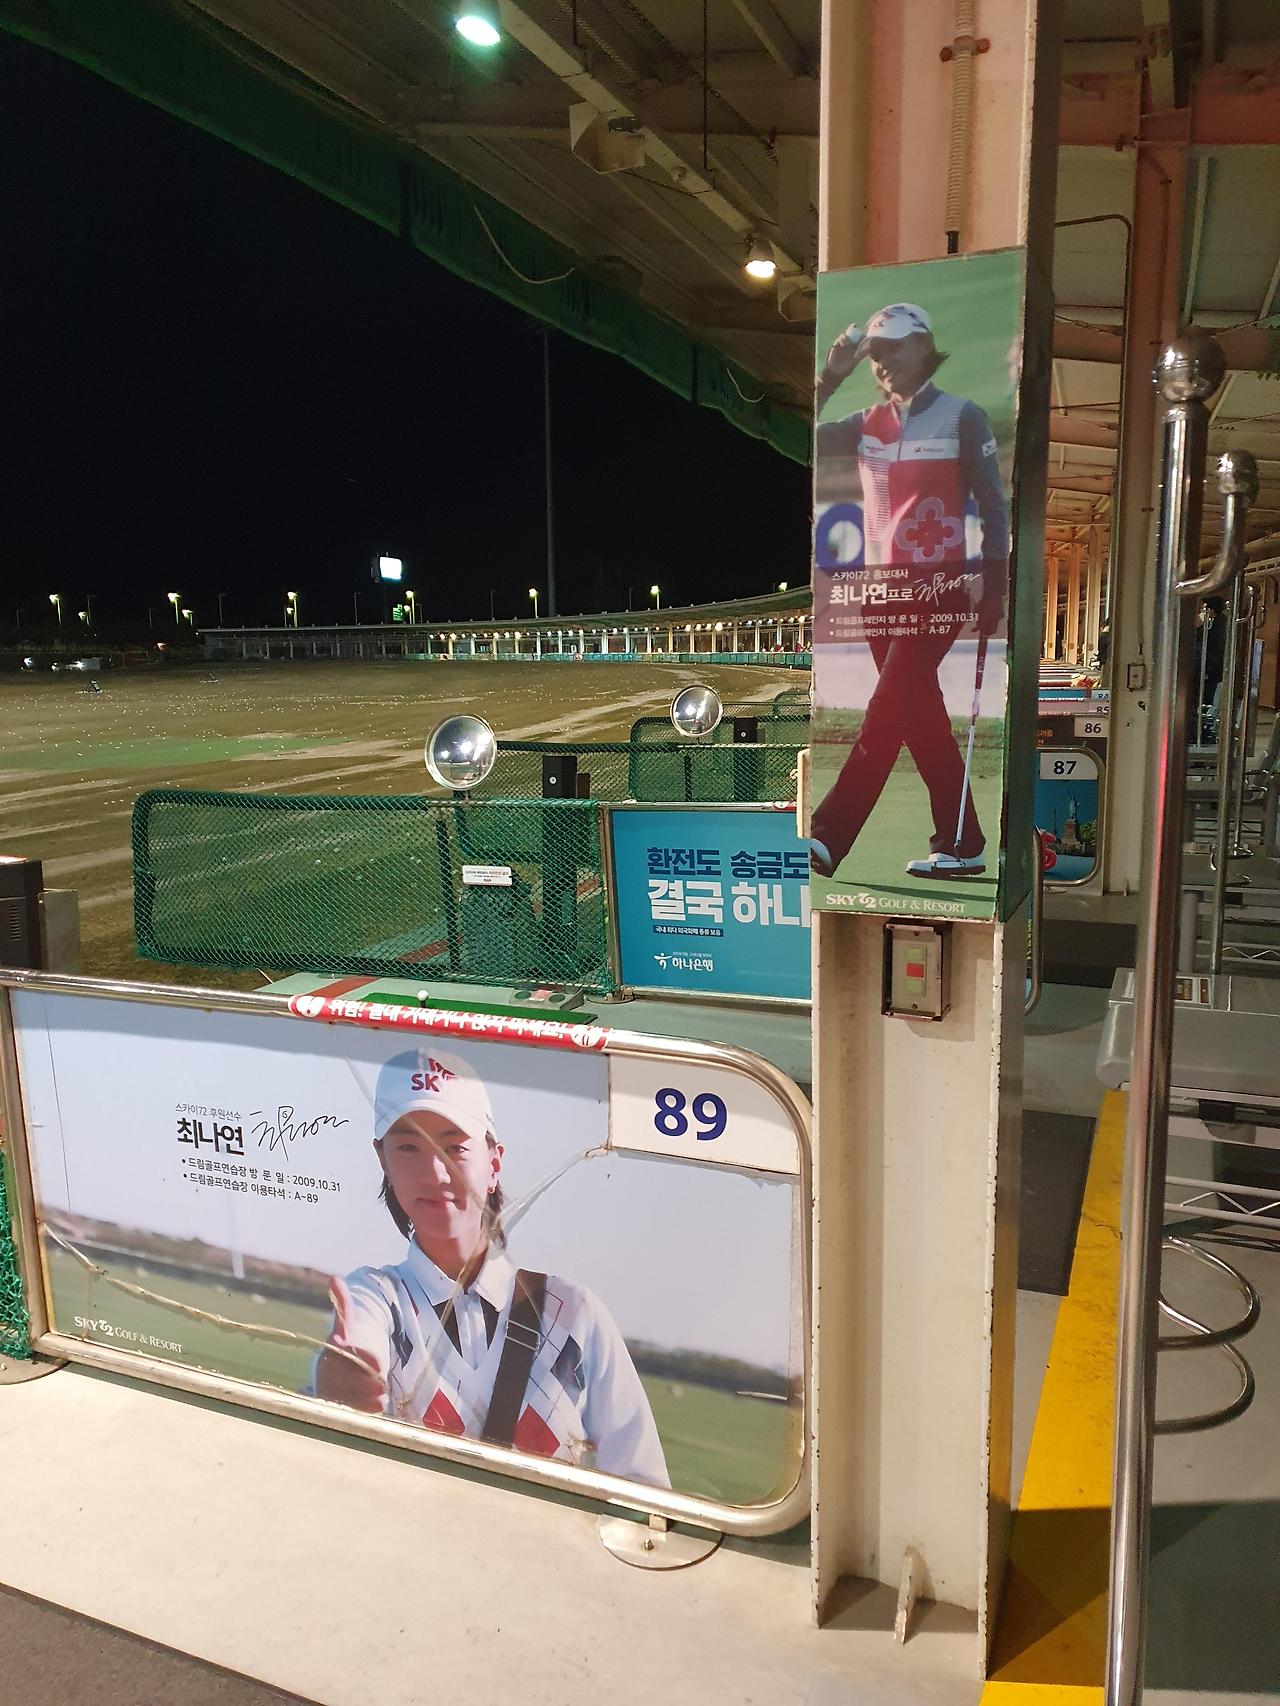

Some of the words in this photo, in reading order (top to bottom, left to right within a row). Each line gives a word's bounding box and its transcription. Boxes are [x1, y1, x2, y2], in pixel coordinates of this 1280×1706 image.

[831, 570, 870, 581] 스카이72
[873, 568, 909, 580] 홍보대사
[929, 613, 979, 623] 2009.10.31
[929, 625, 951, 634] A-87
[1084, 723, 1102, 733] 86
[1053, 760, 1077, 775] 87
[647, 847, 722, 876] 환전도
[730, 850, 810, 880] 송금도
[648, 879, 724, 924] 결국
[878, 898, 907, 909] GOLF
[910, 899, 922, 910] &
[923, 900, 966, 913] RESORT
[672, 957, 713, 972] 하나은행
[411, 1073, 440, 1092] SK
[175, 1103, 208, 1117] 스카이72
[209, 1108, 242, 1121] 후원선수
[654, 1088, 728, 1141] 89
[176, 1117, 245, 1156] 최나연
[188, 1157, 247, 1178] 드림골프연습장
[292, 1175, 341, 1192] 2009.10.31
[190, 1172, 248, 1193] 드림골프연습장
[251, 1183, 286, 1199] 이용타석
[294, 1191, 319, 1204] A-89
[115, 1327, 138, 1341] GOLF
[139, 1334, 148, 1344] &
[149, 1336, 183, 1353] RESORT
